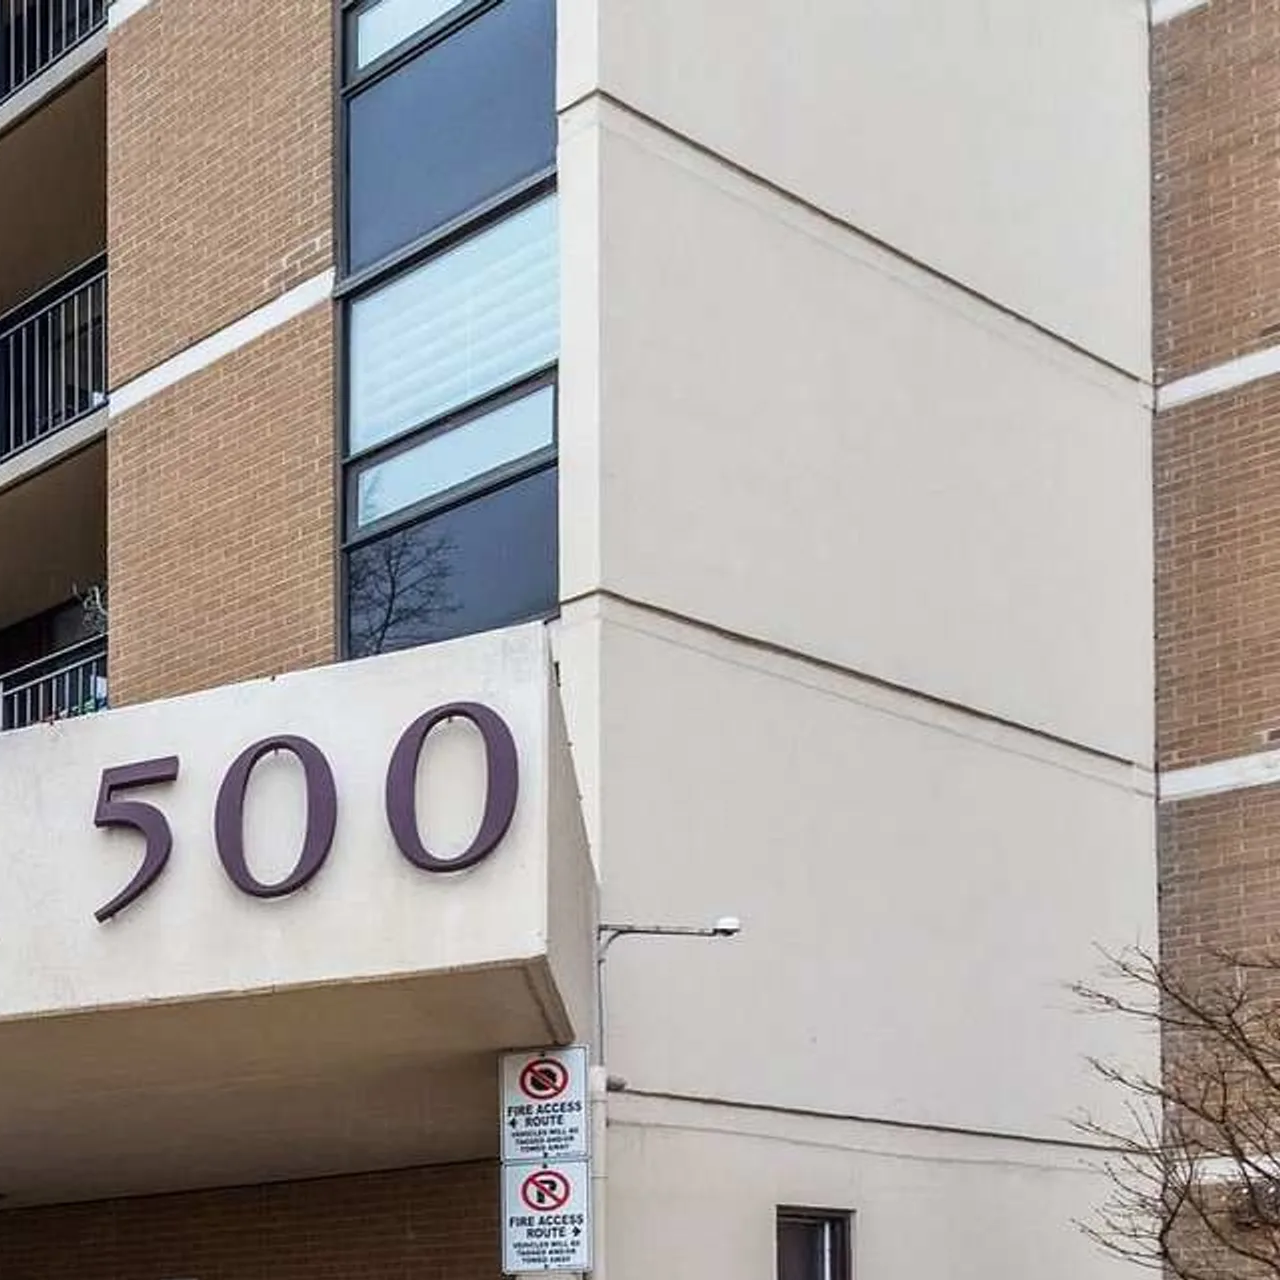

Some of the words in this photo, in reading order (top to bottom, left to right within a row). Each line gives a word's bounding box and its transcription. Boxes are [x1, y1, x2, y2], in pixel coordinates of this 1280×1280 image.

[94, 701, 519, 923] 500
[507, 1105, 533, 1116] FIRE
[536, 1101, 582, 1113] ACCESS
[525, 1115, 563, 1126] ROUTE
[509, 1216, 535, 1227] FIRE
[538, 1215, 583, 1225] ACCESS
[526, 1227, 566, 1238] ROUTE
